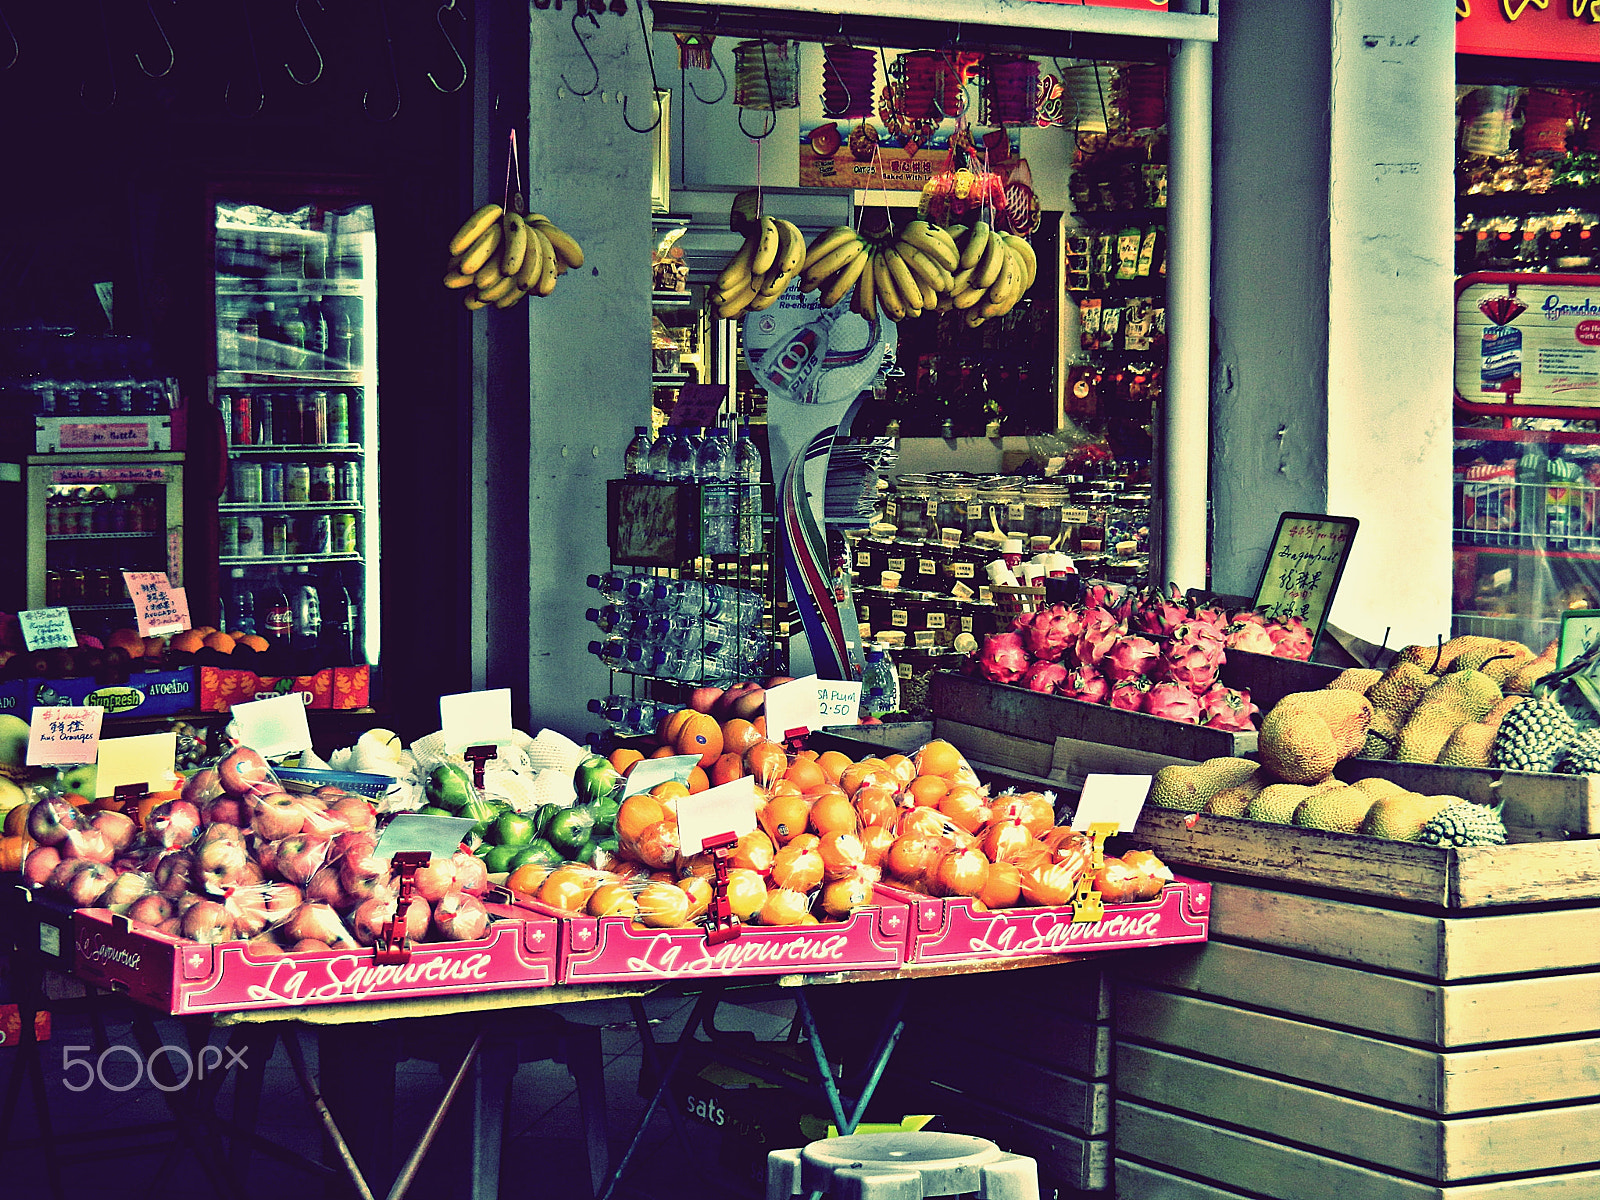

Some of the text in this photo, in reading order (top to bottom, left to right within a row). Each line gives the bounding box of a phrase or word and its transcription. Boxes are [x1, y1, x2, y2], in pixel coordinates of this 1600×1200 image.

[788, 355, 819, 392] PLUS
[144, 609, 177, 619] AVOCADO
[89, 679, 189, 712] Sunfresh AVOCADO
[817, 688, 829, 700] SA
[60, 732, 94, 743] Oranges
[967, 912, 1161, 955] La Savoureuse
[627, 932, 848, 977] La Savoureuse
[248, 953, 493, 1006] La Savoureuse
